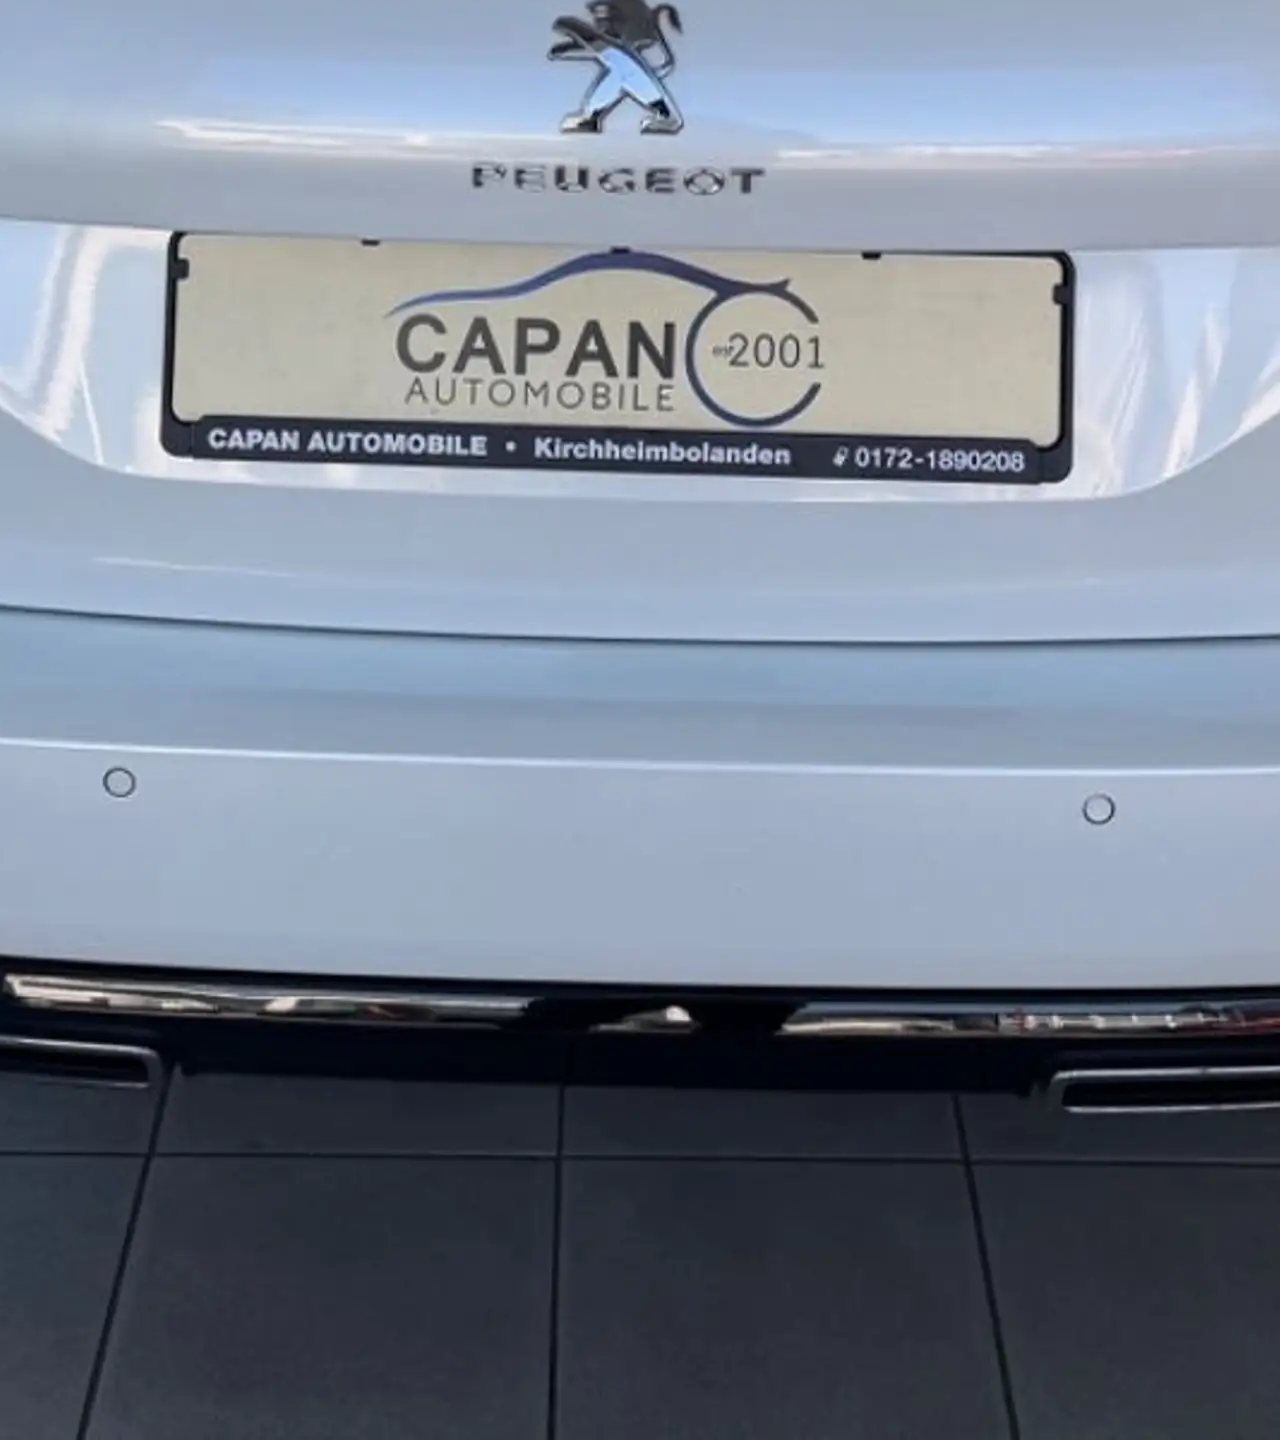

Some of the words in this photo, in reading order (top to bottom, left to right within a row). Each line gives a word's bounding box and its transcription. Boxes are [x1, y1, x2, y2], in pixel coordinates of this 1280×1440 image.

[471, 162, 767, 195] PEUGEOT
[395, 312, 677, 380] CAPAN
[728, 331, 825, 369] 2001
[404, 376, 675, 412] AUTOMOBILE
[207, 427, 300, 451] CAPAN
[307, 430, 488, 456] AUTOMOBILE
[534, 436, 792, 466] Kirchheimbolanden
[854, 446, 1027, 472] 0172-1890208
